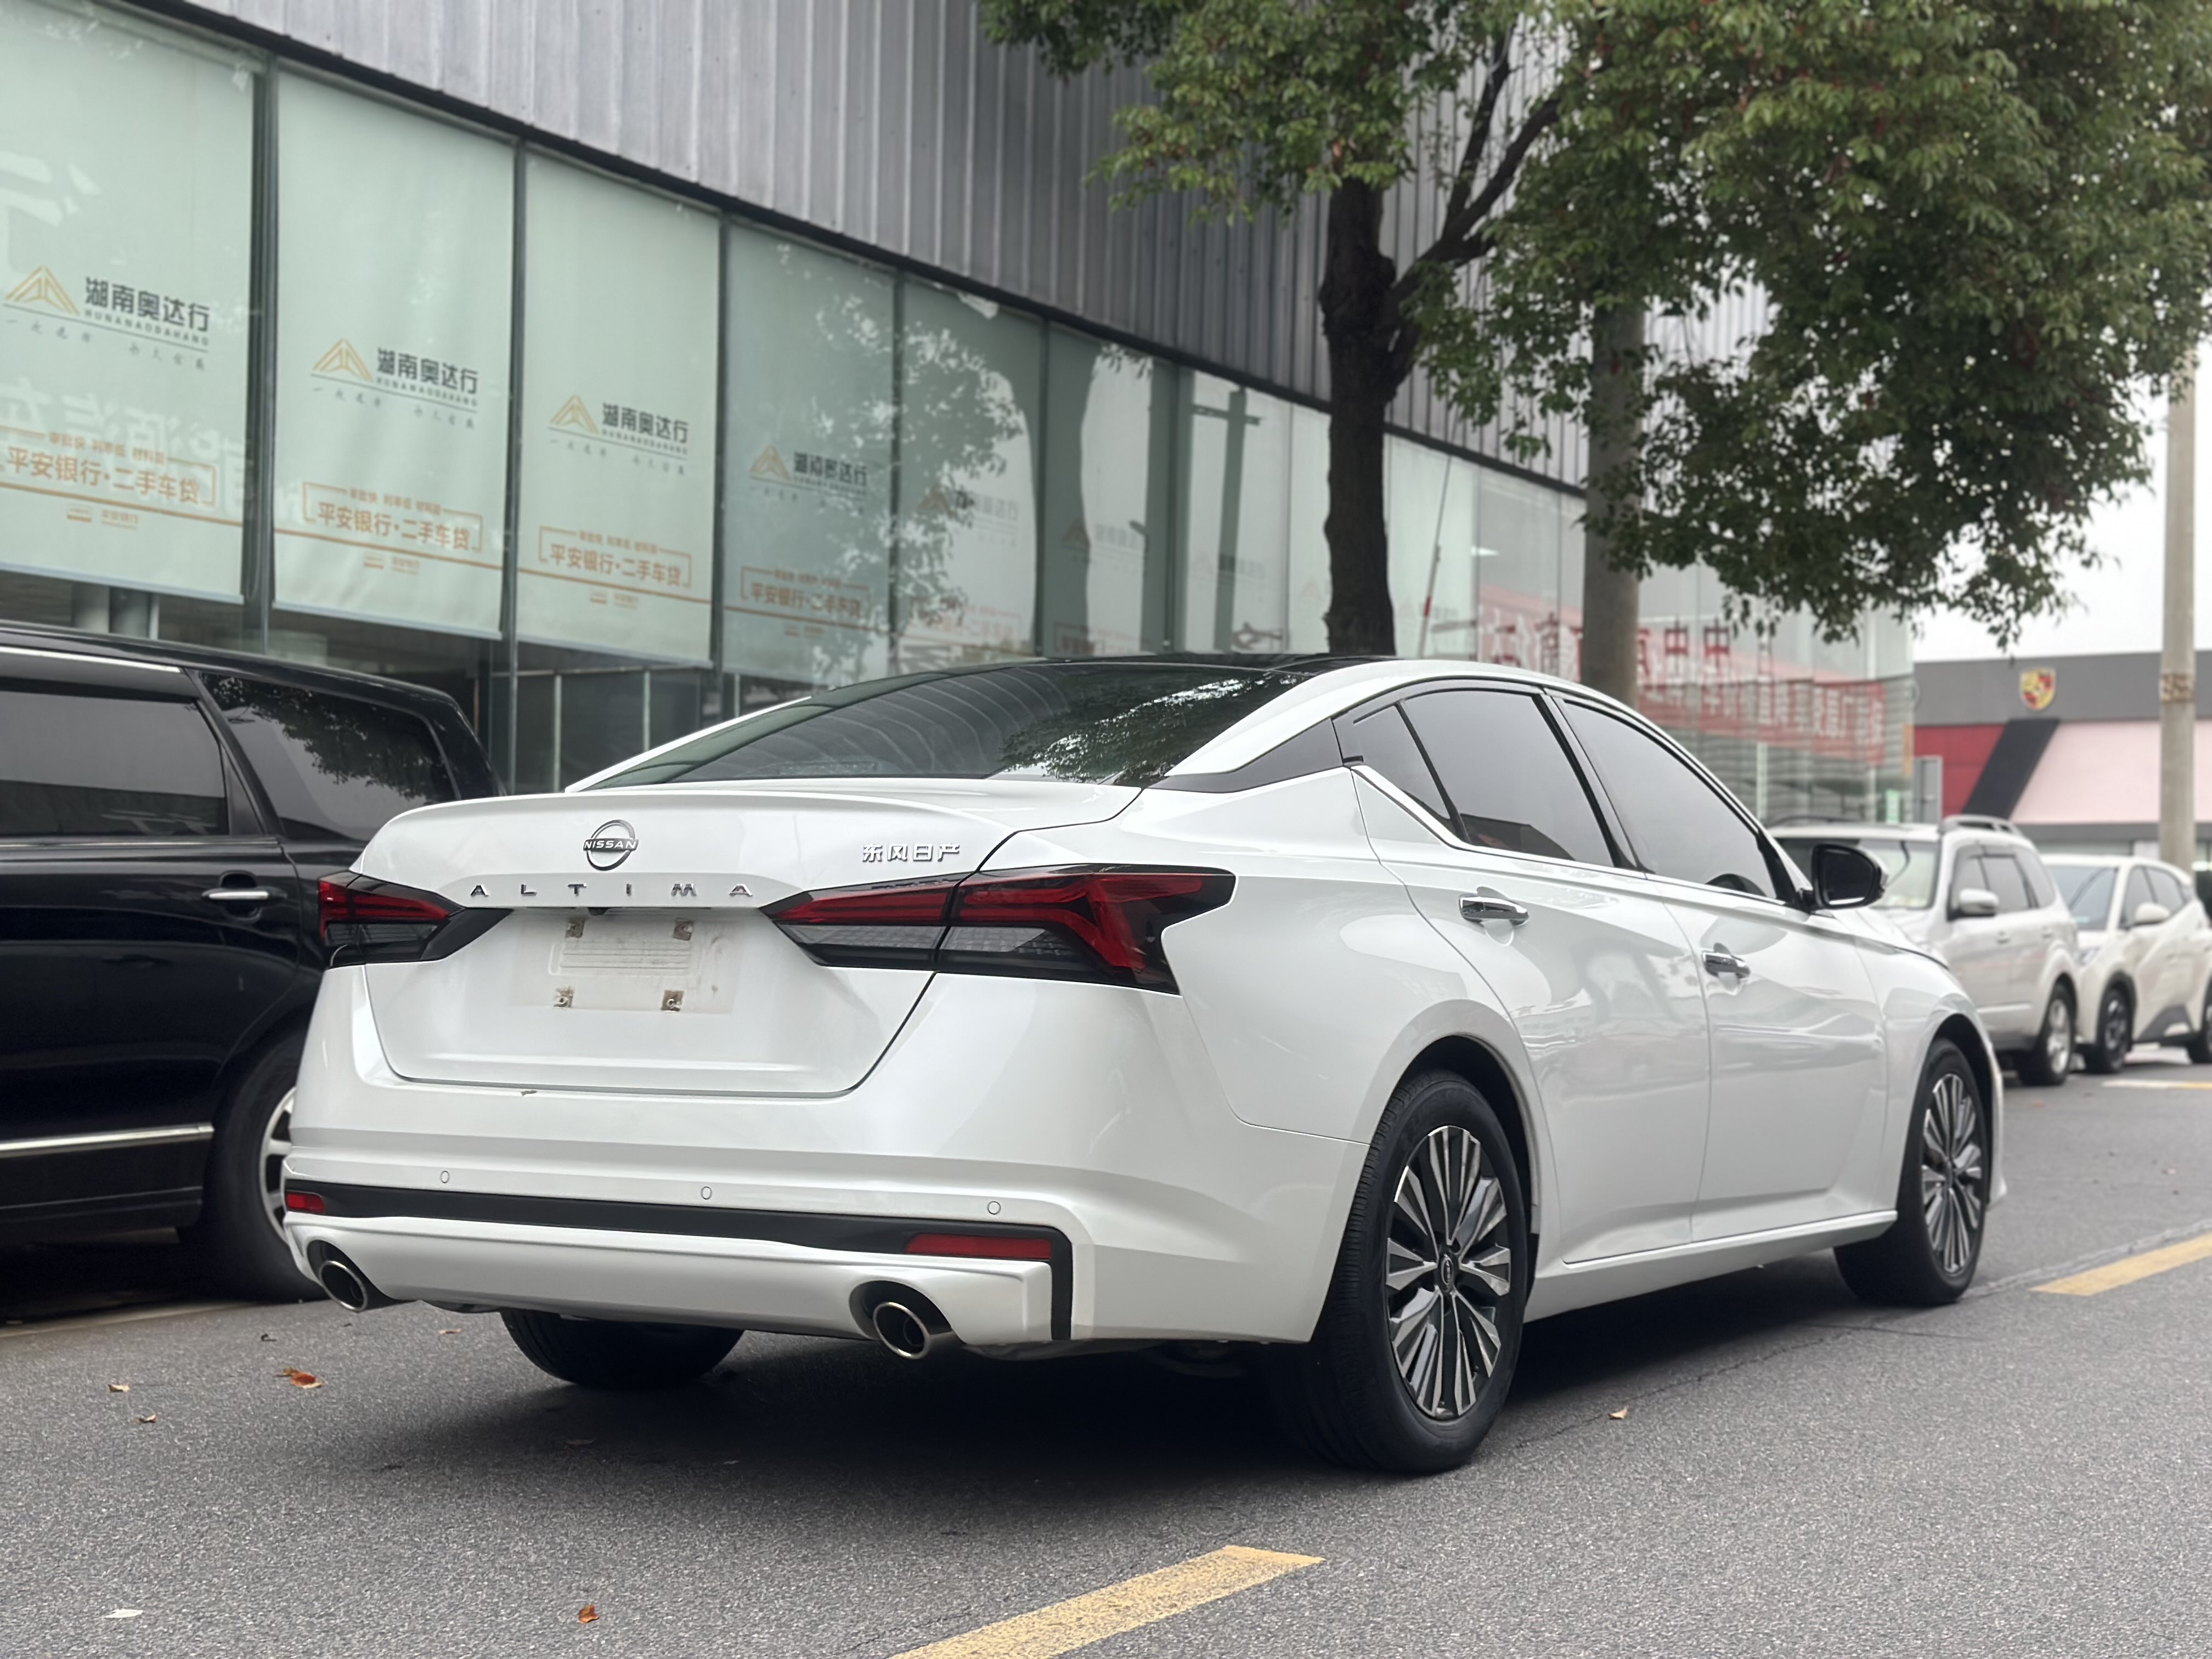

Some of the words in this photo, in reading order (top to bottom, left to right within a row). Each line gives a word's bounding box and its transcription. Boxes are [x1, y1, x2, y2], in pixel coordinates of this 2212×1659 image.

[85, 276, 210, 332] 湖南奥达行
[377, 347, 478, 394] 湖南奥达行
[584, 840, 636, 849] NISSAN
[862, 843, 960, 862] 东风日产
[470, 883, 753, 898] ALTIMA
